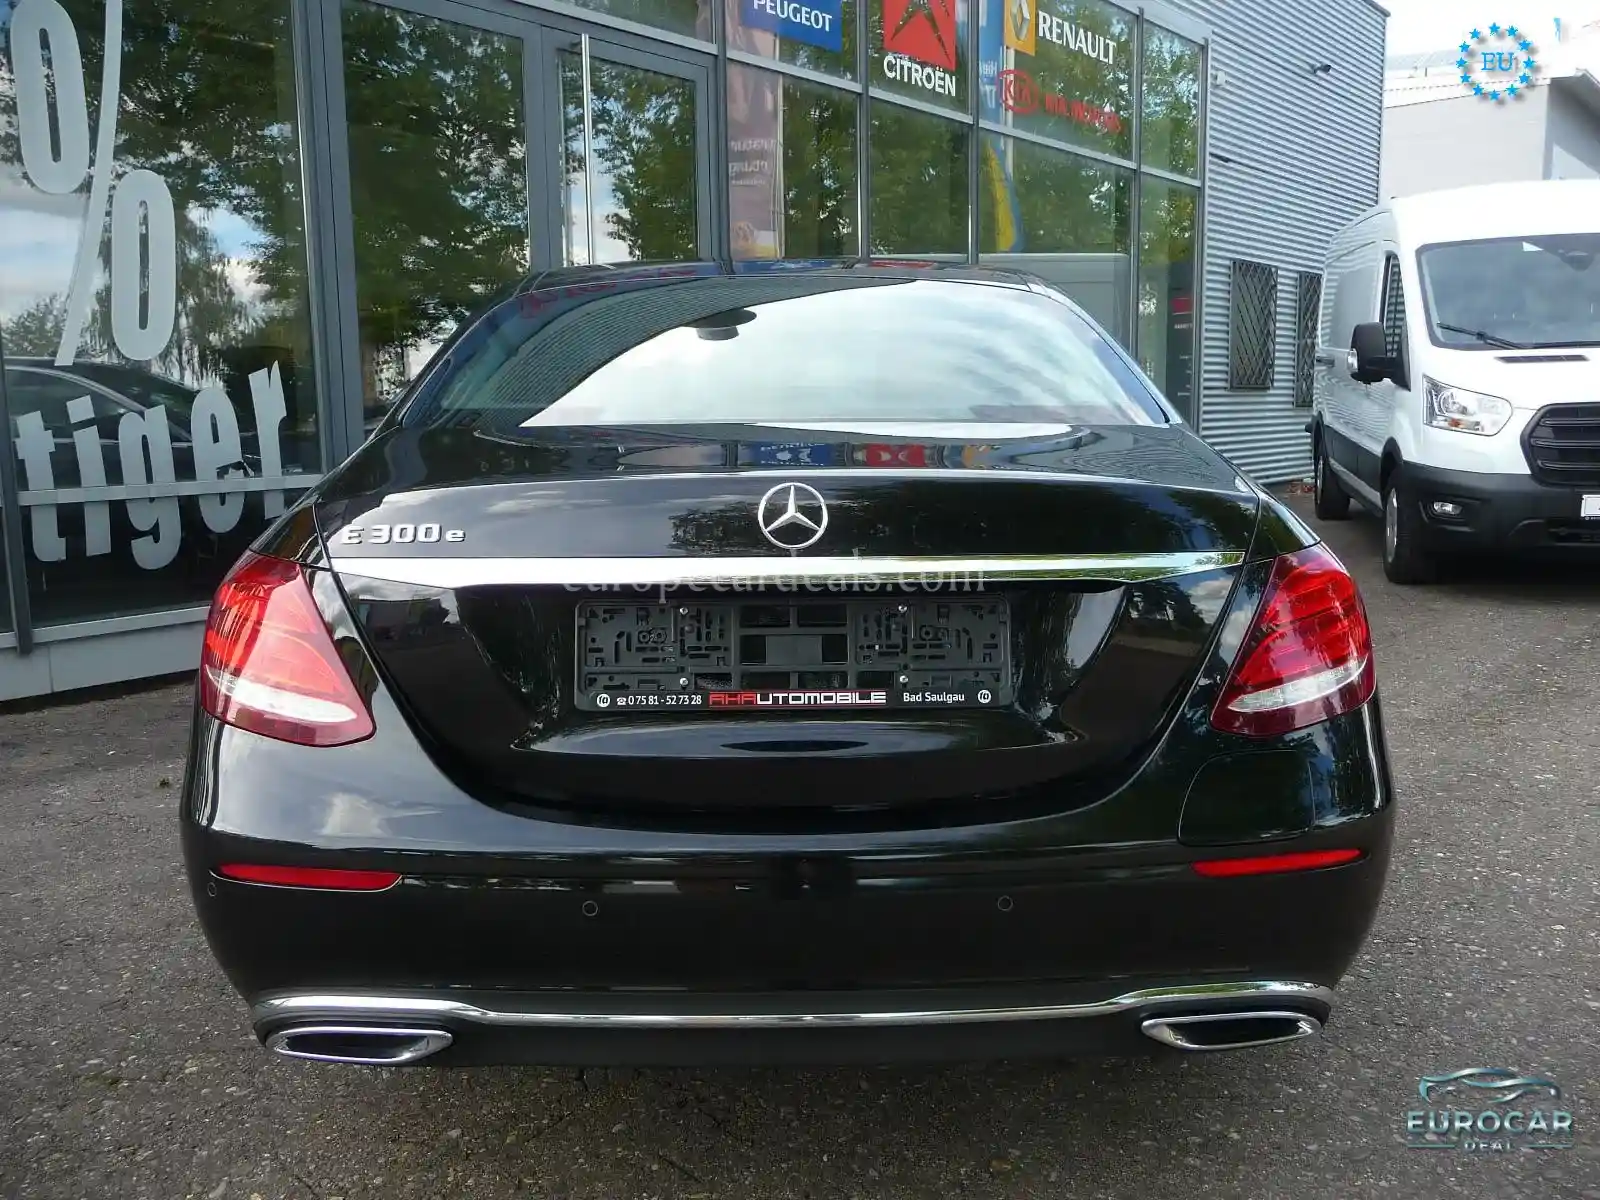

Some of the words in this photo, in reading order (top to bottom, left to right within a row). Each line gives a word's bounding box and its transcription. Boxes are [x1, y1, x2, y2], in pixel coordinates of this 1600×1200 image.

[753, 0, 833, 32] PEUGEOT
[1038, 10, 1117, 65] RENAULT
[883, 54, 956, 97] CITROËN
[15, 360, 288, 570] tiger
[340, 525, 365, 544] E
[368, 523, 442, 544] 300
[445, 529, 466, 543] e
[903, 692, 922, 702] Bad
[924, 691, 965, 703] Saulgau
